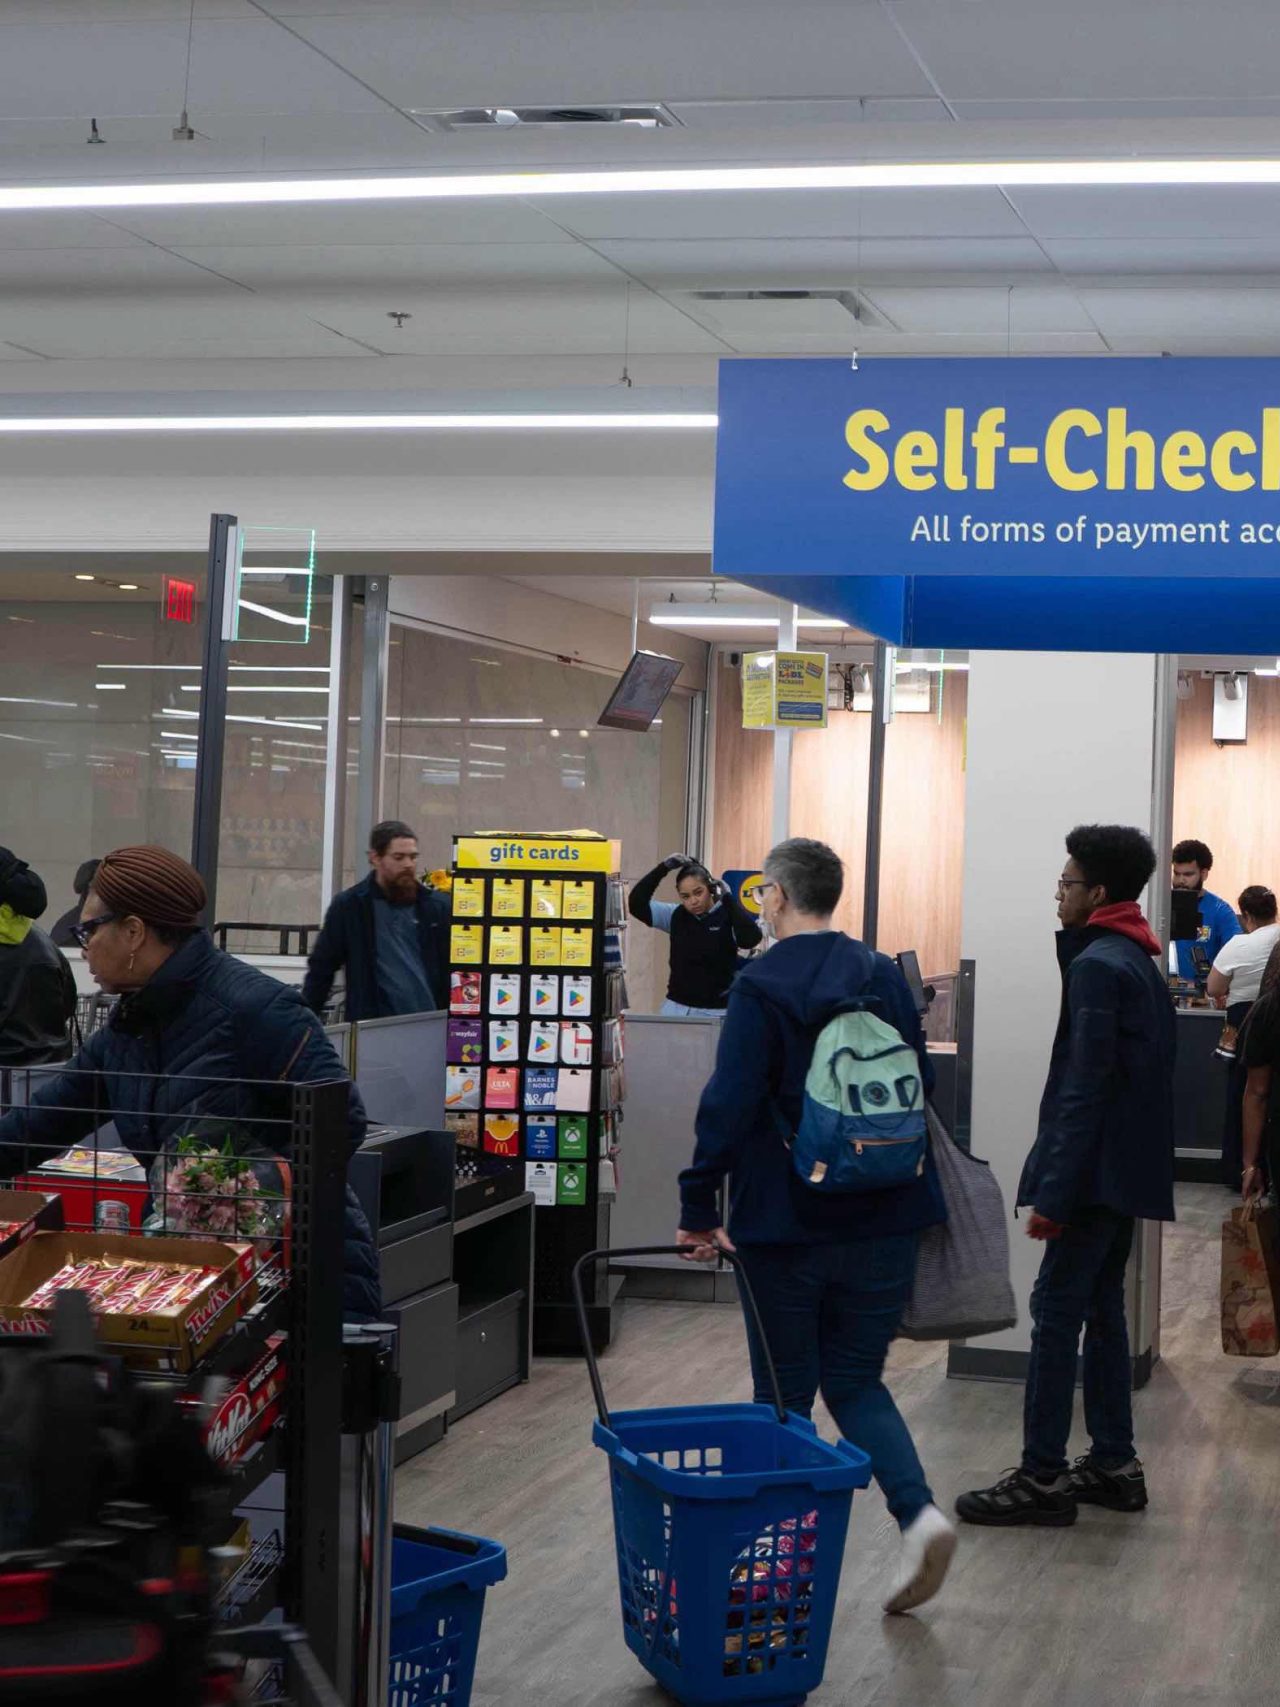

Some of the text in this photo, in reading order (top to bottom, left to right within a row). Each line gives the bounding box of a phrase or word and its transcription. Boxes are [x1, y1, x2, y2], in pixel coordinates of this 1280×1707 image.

[910, 515, 951, 545] All
[960, 515, 1046, 545] forms
[1056, 515, 1087, 545] of
[1095, 519, 1231, 551] payment
[490, 844, 580, 862] gift cards
